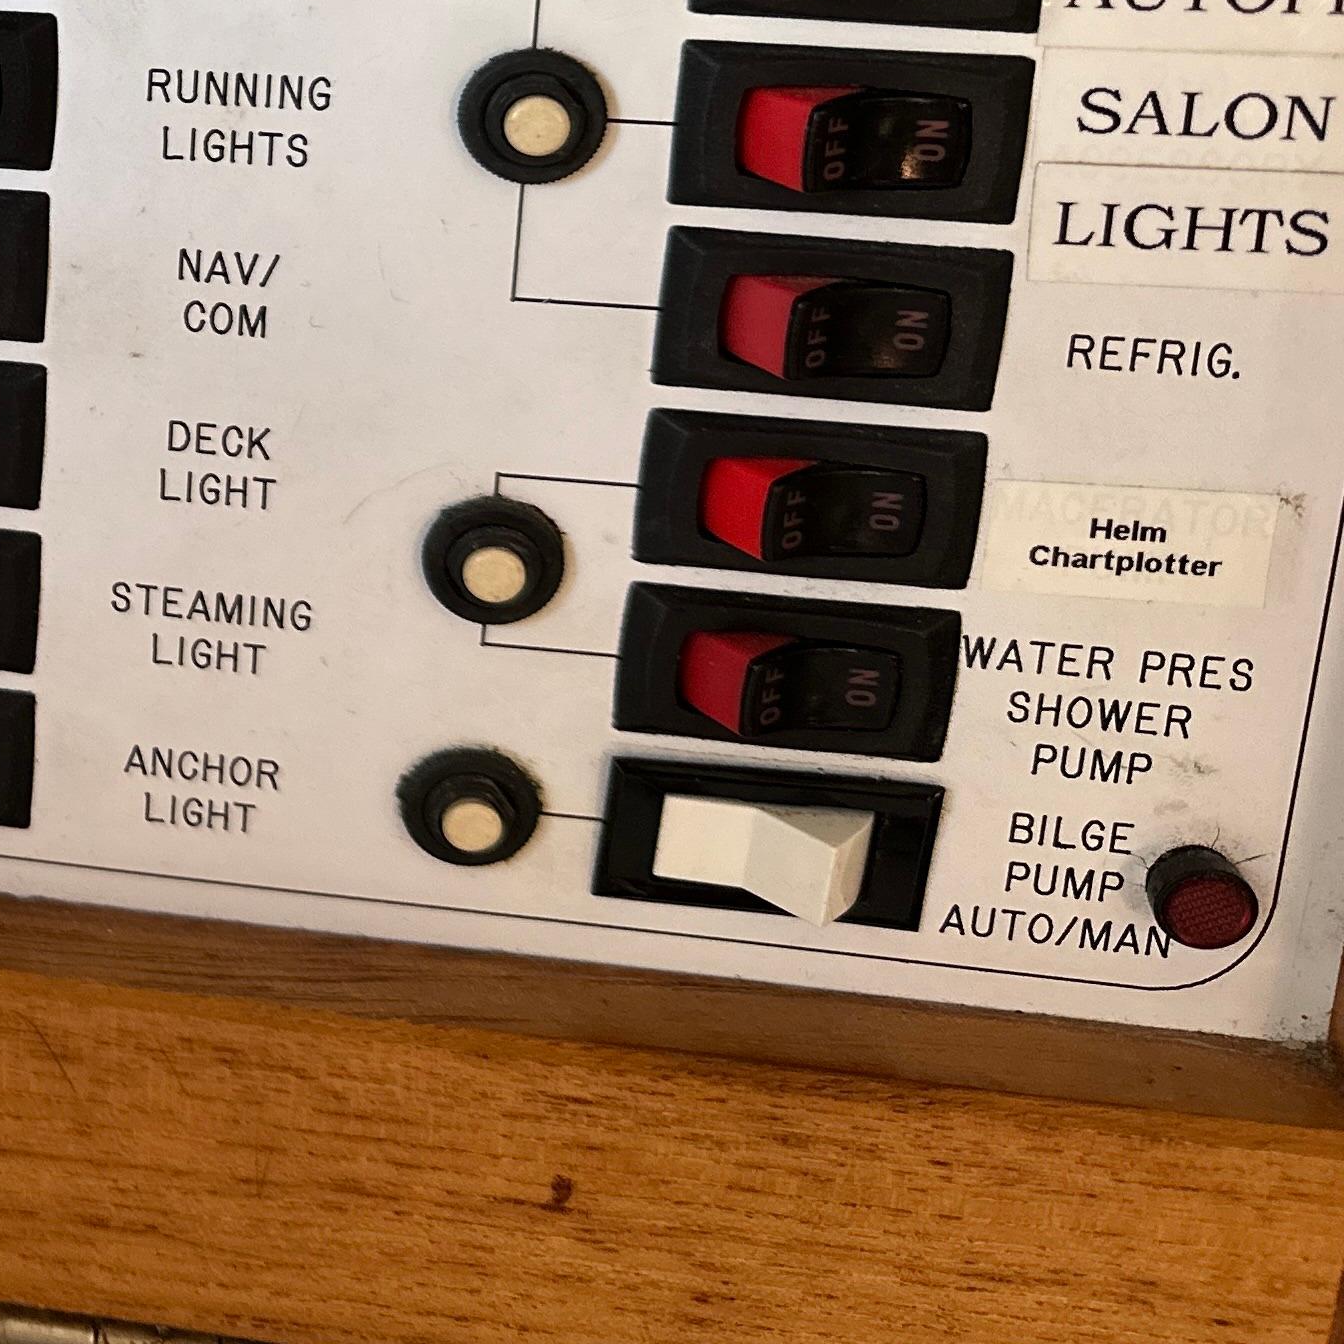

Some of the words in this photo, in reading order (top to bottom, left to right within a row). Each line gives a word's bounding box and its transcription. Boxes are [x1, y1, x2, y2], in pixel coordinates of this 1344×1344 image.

[146, 70, 333, 111] RUNNING
[1077, 86, 1335, 143] SALON
[162, 129, 309, 169] LIGHTS
[1054, 200, 1330, 257] LIGHTS
[177, 249, 280, 287] NAV/
[184, 301, 268, 340] COM
[1066, 335, 1242, 380] REFRIG.
[166, 420, 272, 460] DECK
[159, 470, 277, 511] LIGHT
[1089, 517, 1168, 544] Helm
[1028, 544, 1223, 581] Chartplotter
[111, 581, 313, 633] STEAMING
[151, 634, 267, 675] LIGHT
[962, 635, 1114, 682] WATER
[1139, 650, 1255, 693] PRES
[1007, 694, 1193, 739] SHOWER
[123, 745, 281, 789] ANCHOR
[1030, 744, 1154, 786] PUMP
[142, 793, 257, 834] LIGHT
[1008, 812, 1135, 856] BILGE
[1004, 861, 1126, 903] PUMP
[939, 903, 1172, 959] AUTO/MAN
